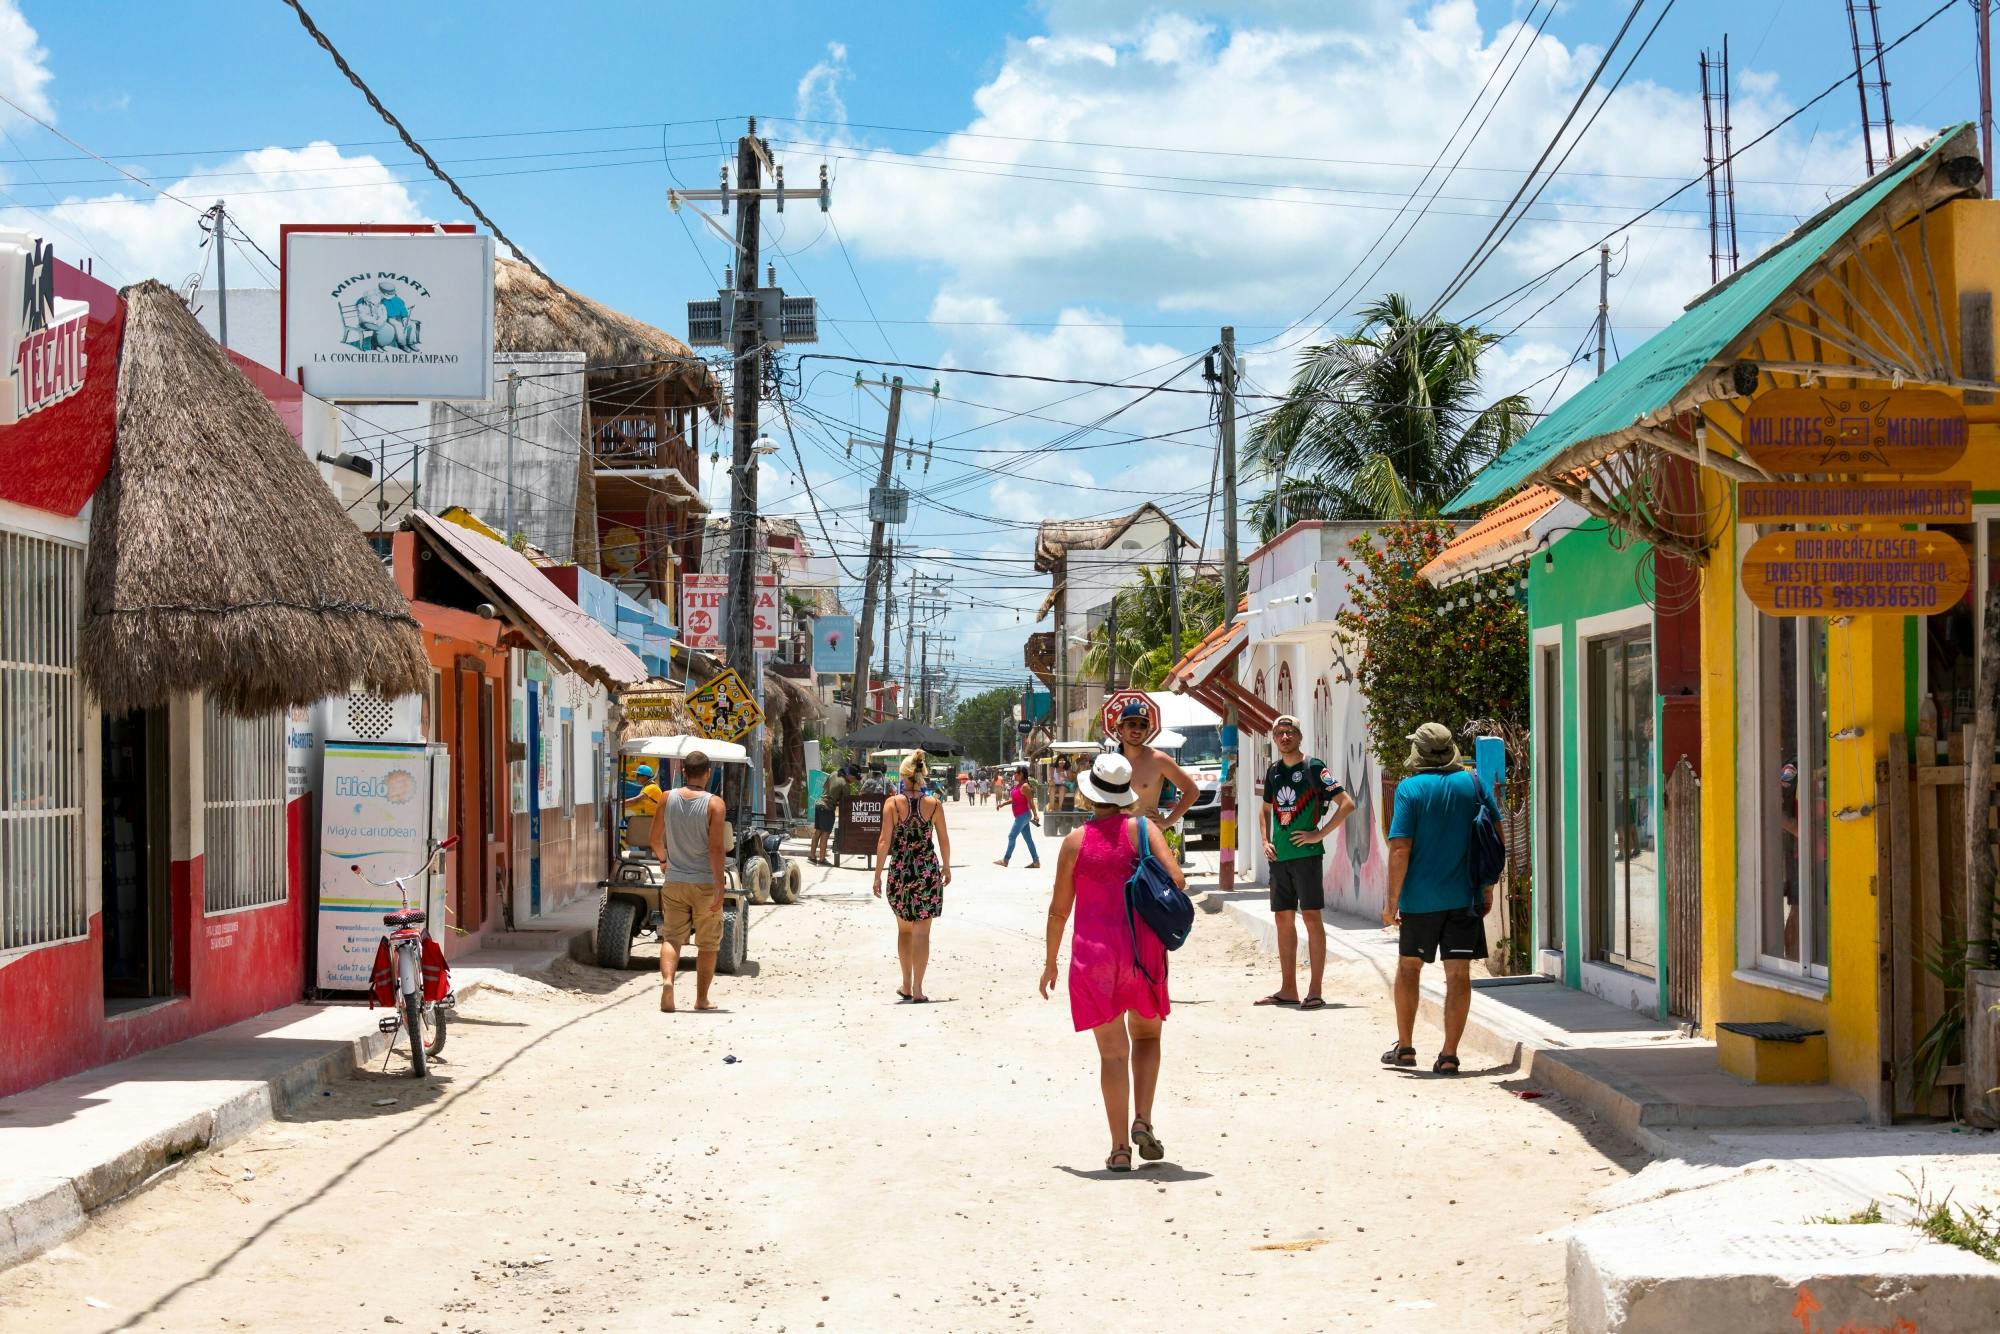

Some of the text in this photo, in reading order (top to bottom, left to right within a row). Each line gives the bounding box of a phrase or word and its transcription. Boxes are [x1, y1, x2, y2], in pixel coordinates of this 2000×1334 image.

[331, 271, 431, 299] MINI MART
[16, 315, 89, 412] TECATE
[314, 352, 459, 364] LA CONCHUELA DEL PÁMPANO
[1750, 417, 1965, 447] MUJERES MEDICINA
[1795, 539, 1822, 560] AIDA
[1764, 562, 1818, 583] ERNESTO
[685, 592, 775, 608] TIEA
[1774, 586, 1824, 608] CITAS
[689, 615, 711, 628] 24
[852, 800, 881, 812] NITRO
[855, 815, 881, 823] COFFEE
[327, 825, 358, 839] Maya
